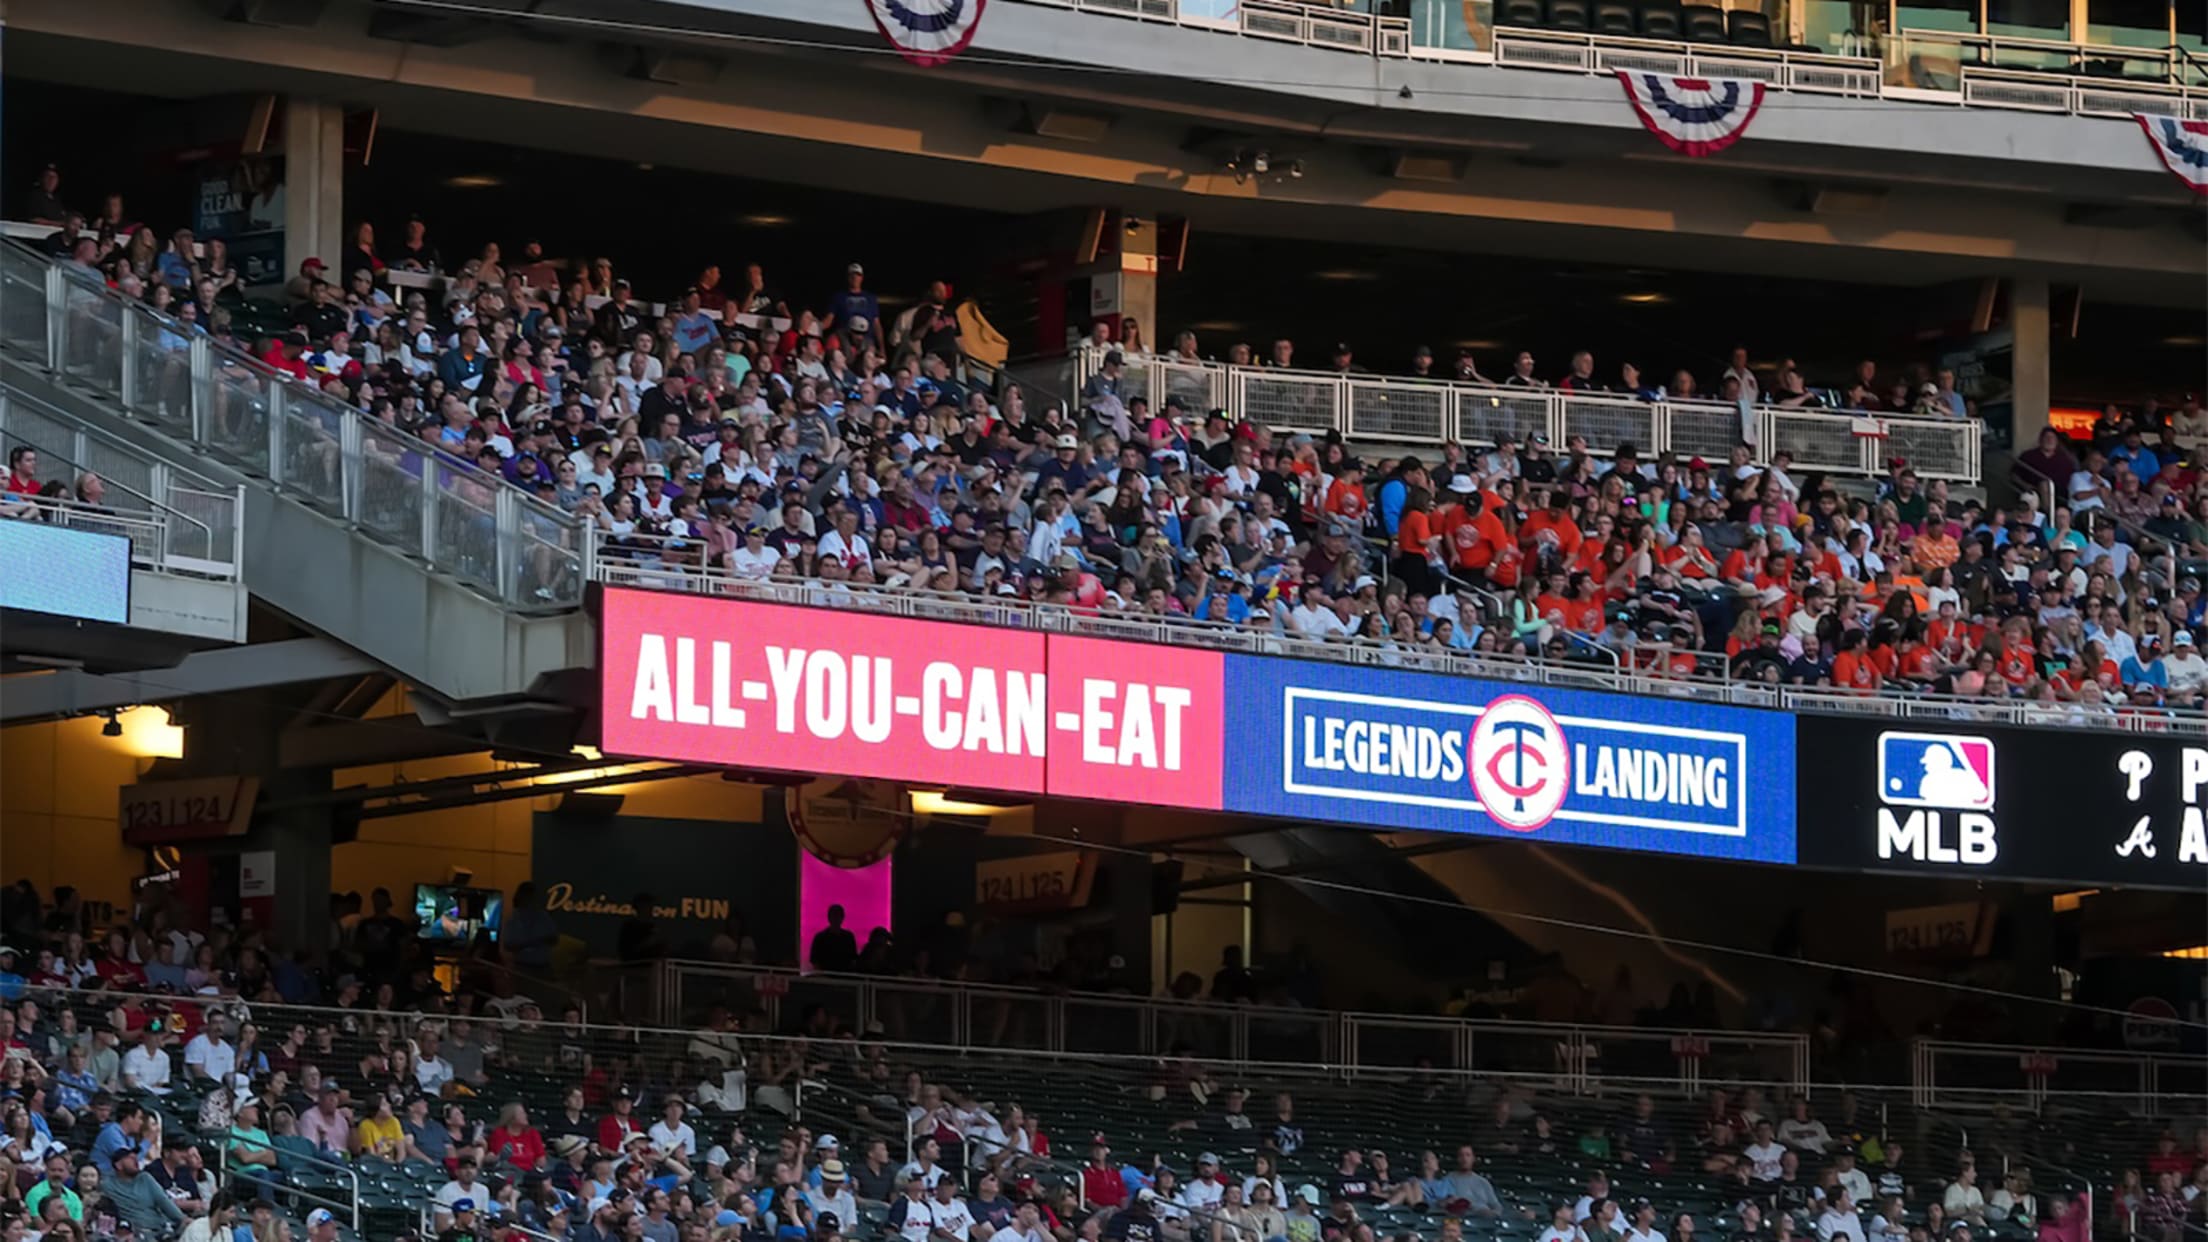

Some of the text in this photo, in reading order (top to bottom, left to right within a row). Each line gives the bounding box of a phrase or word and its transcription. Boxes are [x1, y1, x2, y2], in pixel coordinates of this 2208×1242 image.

[631, 633, 1192, 771] ALL-YOU-CAN-EAT
[1304, 715, 1464, 782] LEGENDS
[1575, 743, 1728, 809] LANDING
[125, 796, 220, 828] 123 124
[1877, 808, 1998, 864] MLB
[545, 881, 730, 920] Destinaon FUN
[981, 871, 1064, 903] 124 125
